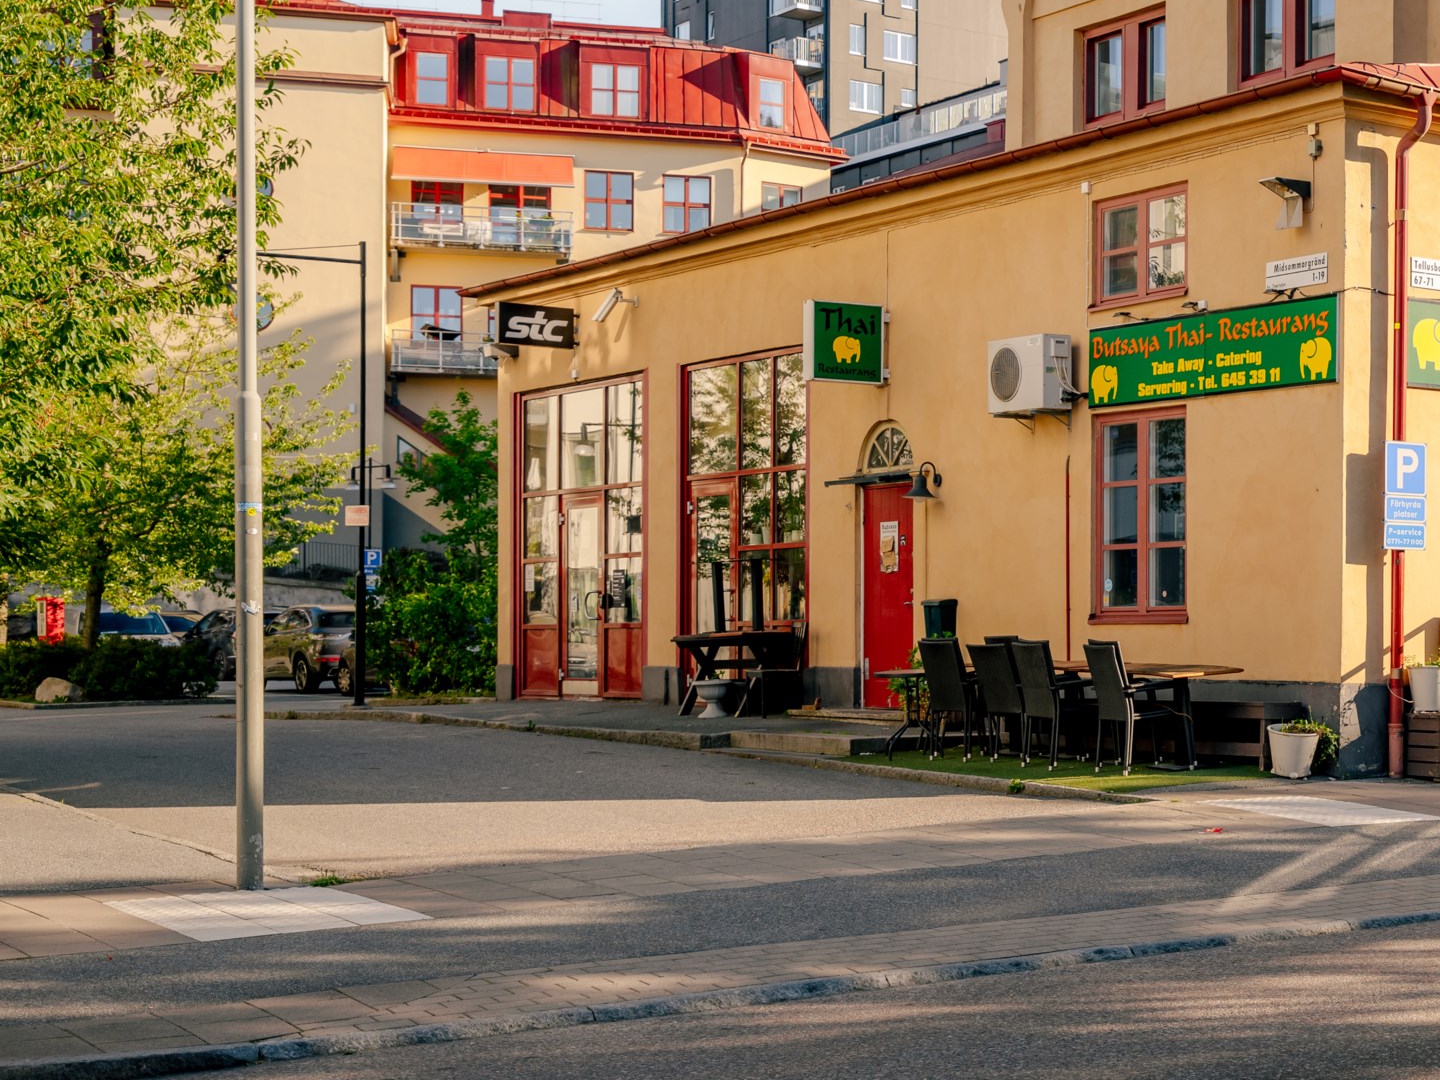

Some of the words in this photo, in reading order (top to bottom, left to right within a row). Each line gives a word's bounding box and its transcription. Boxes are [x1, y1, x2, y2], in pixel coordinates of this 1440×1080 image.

[1273, 255, 1326, 273] Midsommargränd
[1312, 271, 1325, 282] 1-19
[1414, 275, 1434, 287] 67-71
[504, 310, 569, 343] stc
[819, 306, 876, 336] Thai
[1092, 335, 1160, 359] Butsaya
[1219, 311, 1329, 341] Restaurang
[818, 362, 877, 379] Restaurang
[1151, 360, 1174, 376] Take
[1177, 357, 1205, 373] Away
[1216, 349, 1262, 368] Catering
[1137, 378, 1188, 398] Servering
[1197, 374, 1218, 391] Tel.
[1221, 370, 1246, 388] 645
[1249, 368, 1266, 384] 39
[1269, 367, 1281, 382] 11
[1397, 448, 1419, 489] P
[1390, 499, 1421, 509] Förhyrda
[1393, 510, 1418, 519] platser
[1388, 528, 1422, 536] P-service
